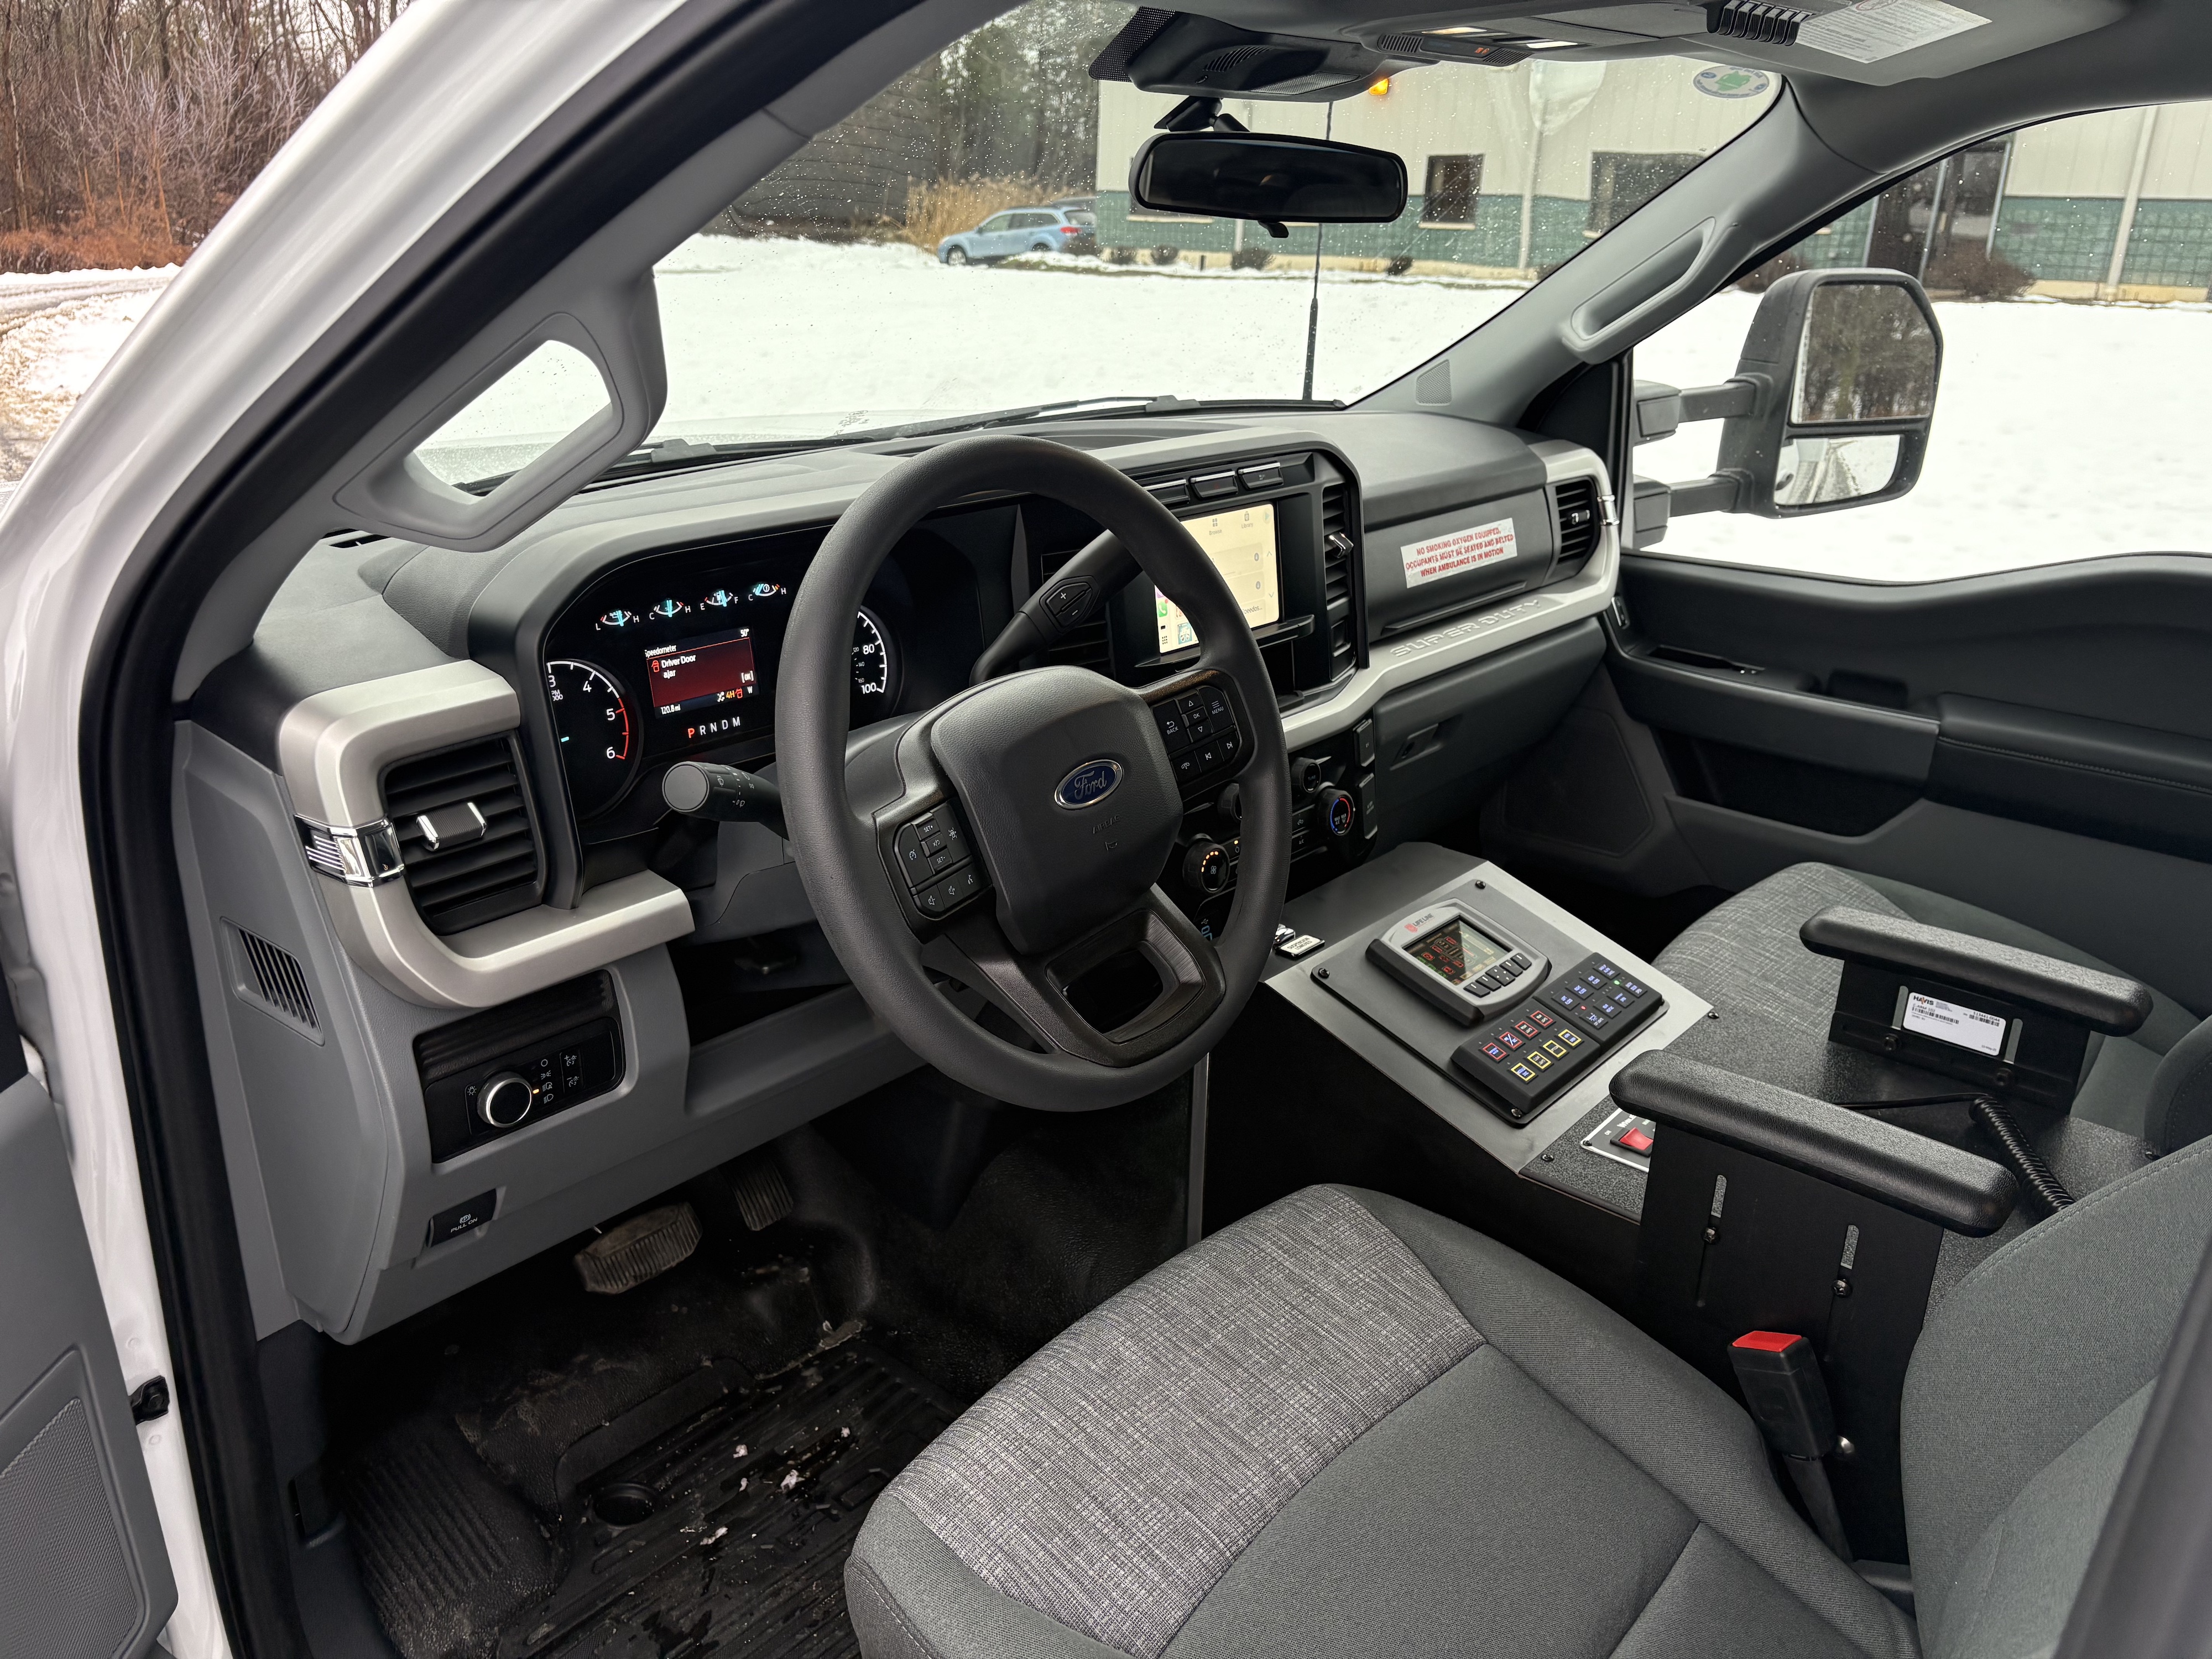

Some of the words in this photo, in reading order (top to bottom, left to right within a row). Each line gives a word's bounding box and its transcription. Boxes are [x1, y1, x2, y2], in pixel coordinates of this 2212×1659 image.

[1416, 547, 1425, 556] NO
[1426, 540, 1451, 553] SMOKING
[1452, 534, 1474, 546] OXYGEN
[1405, 555, 1439, 570] OCCUPANTS
[1439, 550, 1454, 561] MUST
[1455, 548, 1463, 556] BE
[1464, 542, 1483, 554] SEATED
[1484, 539, 1495, 548] AND
[1495, 534, 1514, 545] BELTED
[1420, 566, 1437, 577] WHEN
[1438, 556, 1470, 572] AMBULANCE
[1471, 555, 1477, 563] IS
[1484, 547, 1504, 559] MOTION
[633, 615, 640, 623] H
[1390, 622, 1480, 657] SUPER
[1478, 599, 1541, 625] DUTY
[863, 643, 875, 655] 80
[661, 658, 680, 669] Driver
[681, 654, 697, 664] Door
[662, 669, 676, 679] ajar
[548, 675, 556, 687] 3
[582, 680, 592, 693] 4
[726, 690, 735, 699] 4H
[747, 686, 753, 694] W
[861, 682, 877, 695] 100
[606, 708, 615, 721] 5
[1212, 706, 1224, 715] MENU
[687, 728, 695, 738] P
[699, 725, 706, 735] R
[710, 722, 717, 733] N
[722, 719, 729, 730] D
[732, 716, 740, 727] M
[1166, 726, 1179, 735] BACK
[606, 747, 615, 759] 6
[1074, 770, 1107, 800] Ford
[1913, 995, 1934, 1005] HAVIS
[450, 1223, 467, 1233] PULL
